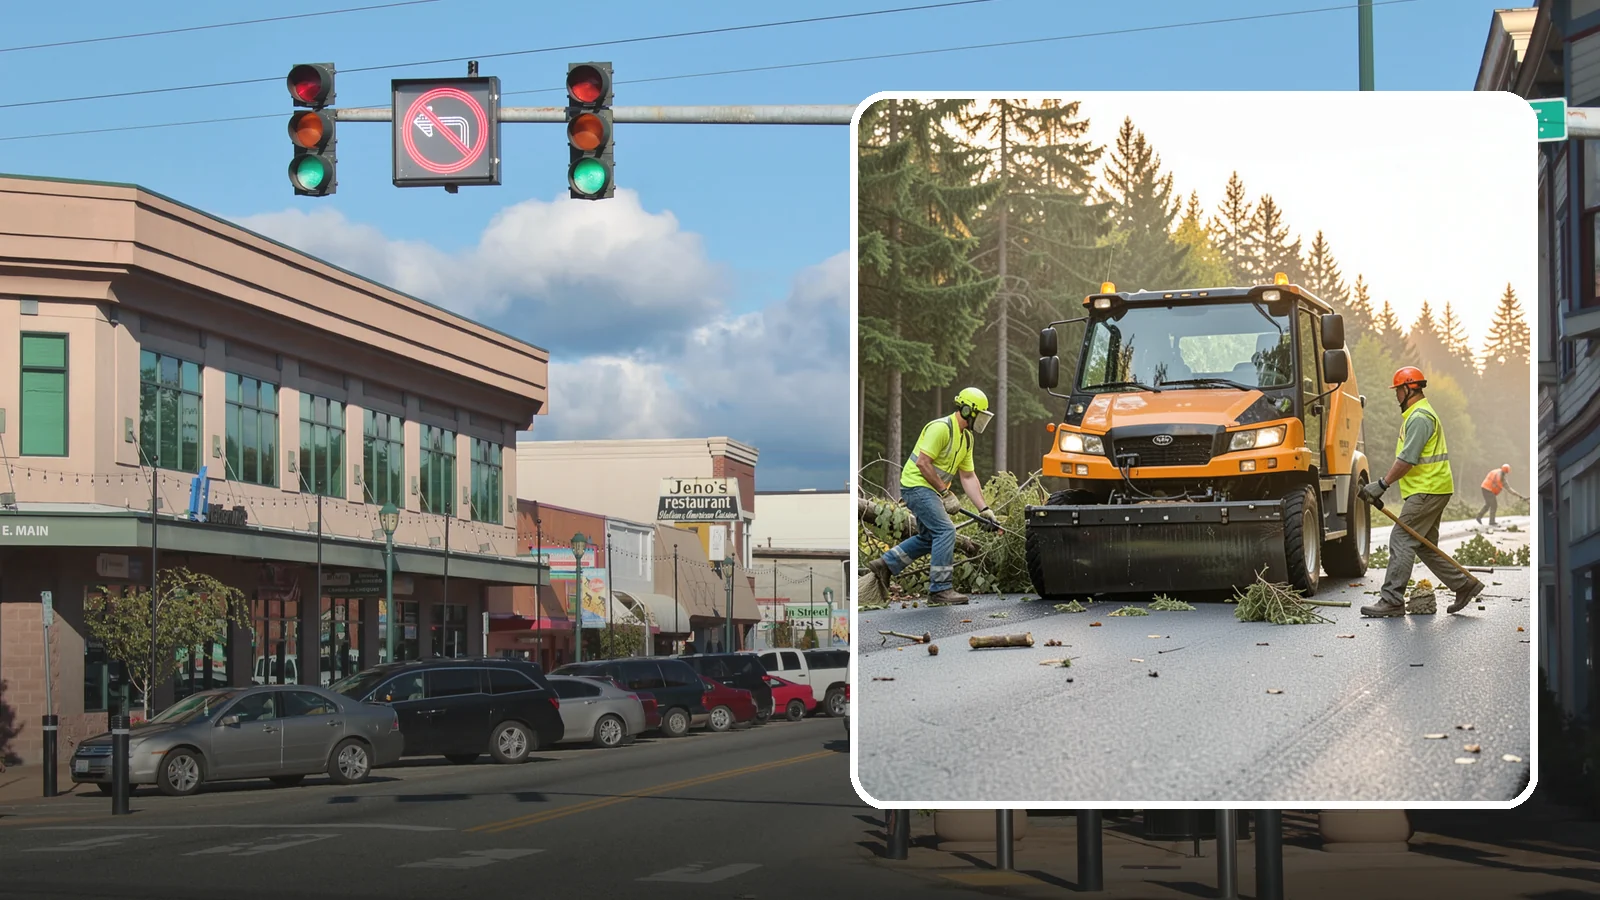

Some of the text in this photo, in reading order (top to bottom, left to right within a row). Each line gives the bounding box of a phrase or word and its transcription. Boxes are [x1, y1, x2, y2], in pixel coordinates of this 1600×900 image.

[670, 480, 727, 494] Jeno's
[665, 496, 731, 509] restaurant
[658, 509, 681, 519] Italian
[686, 509, 714, 519] American
[715, 509, 737, 519] Cuisine
[2, 525, 49, 536] E. MAIN
[797, 608, 828, 617] Street
